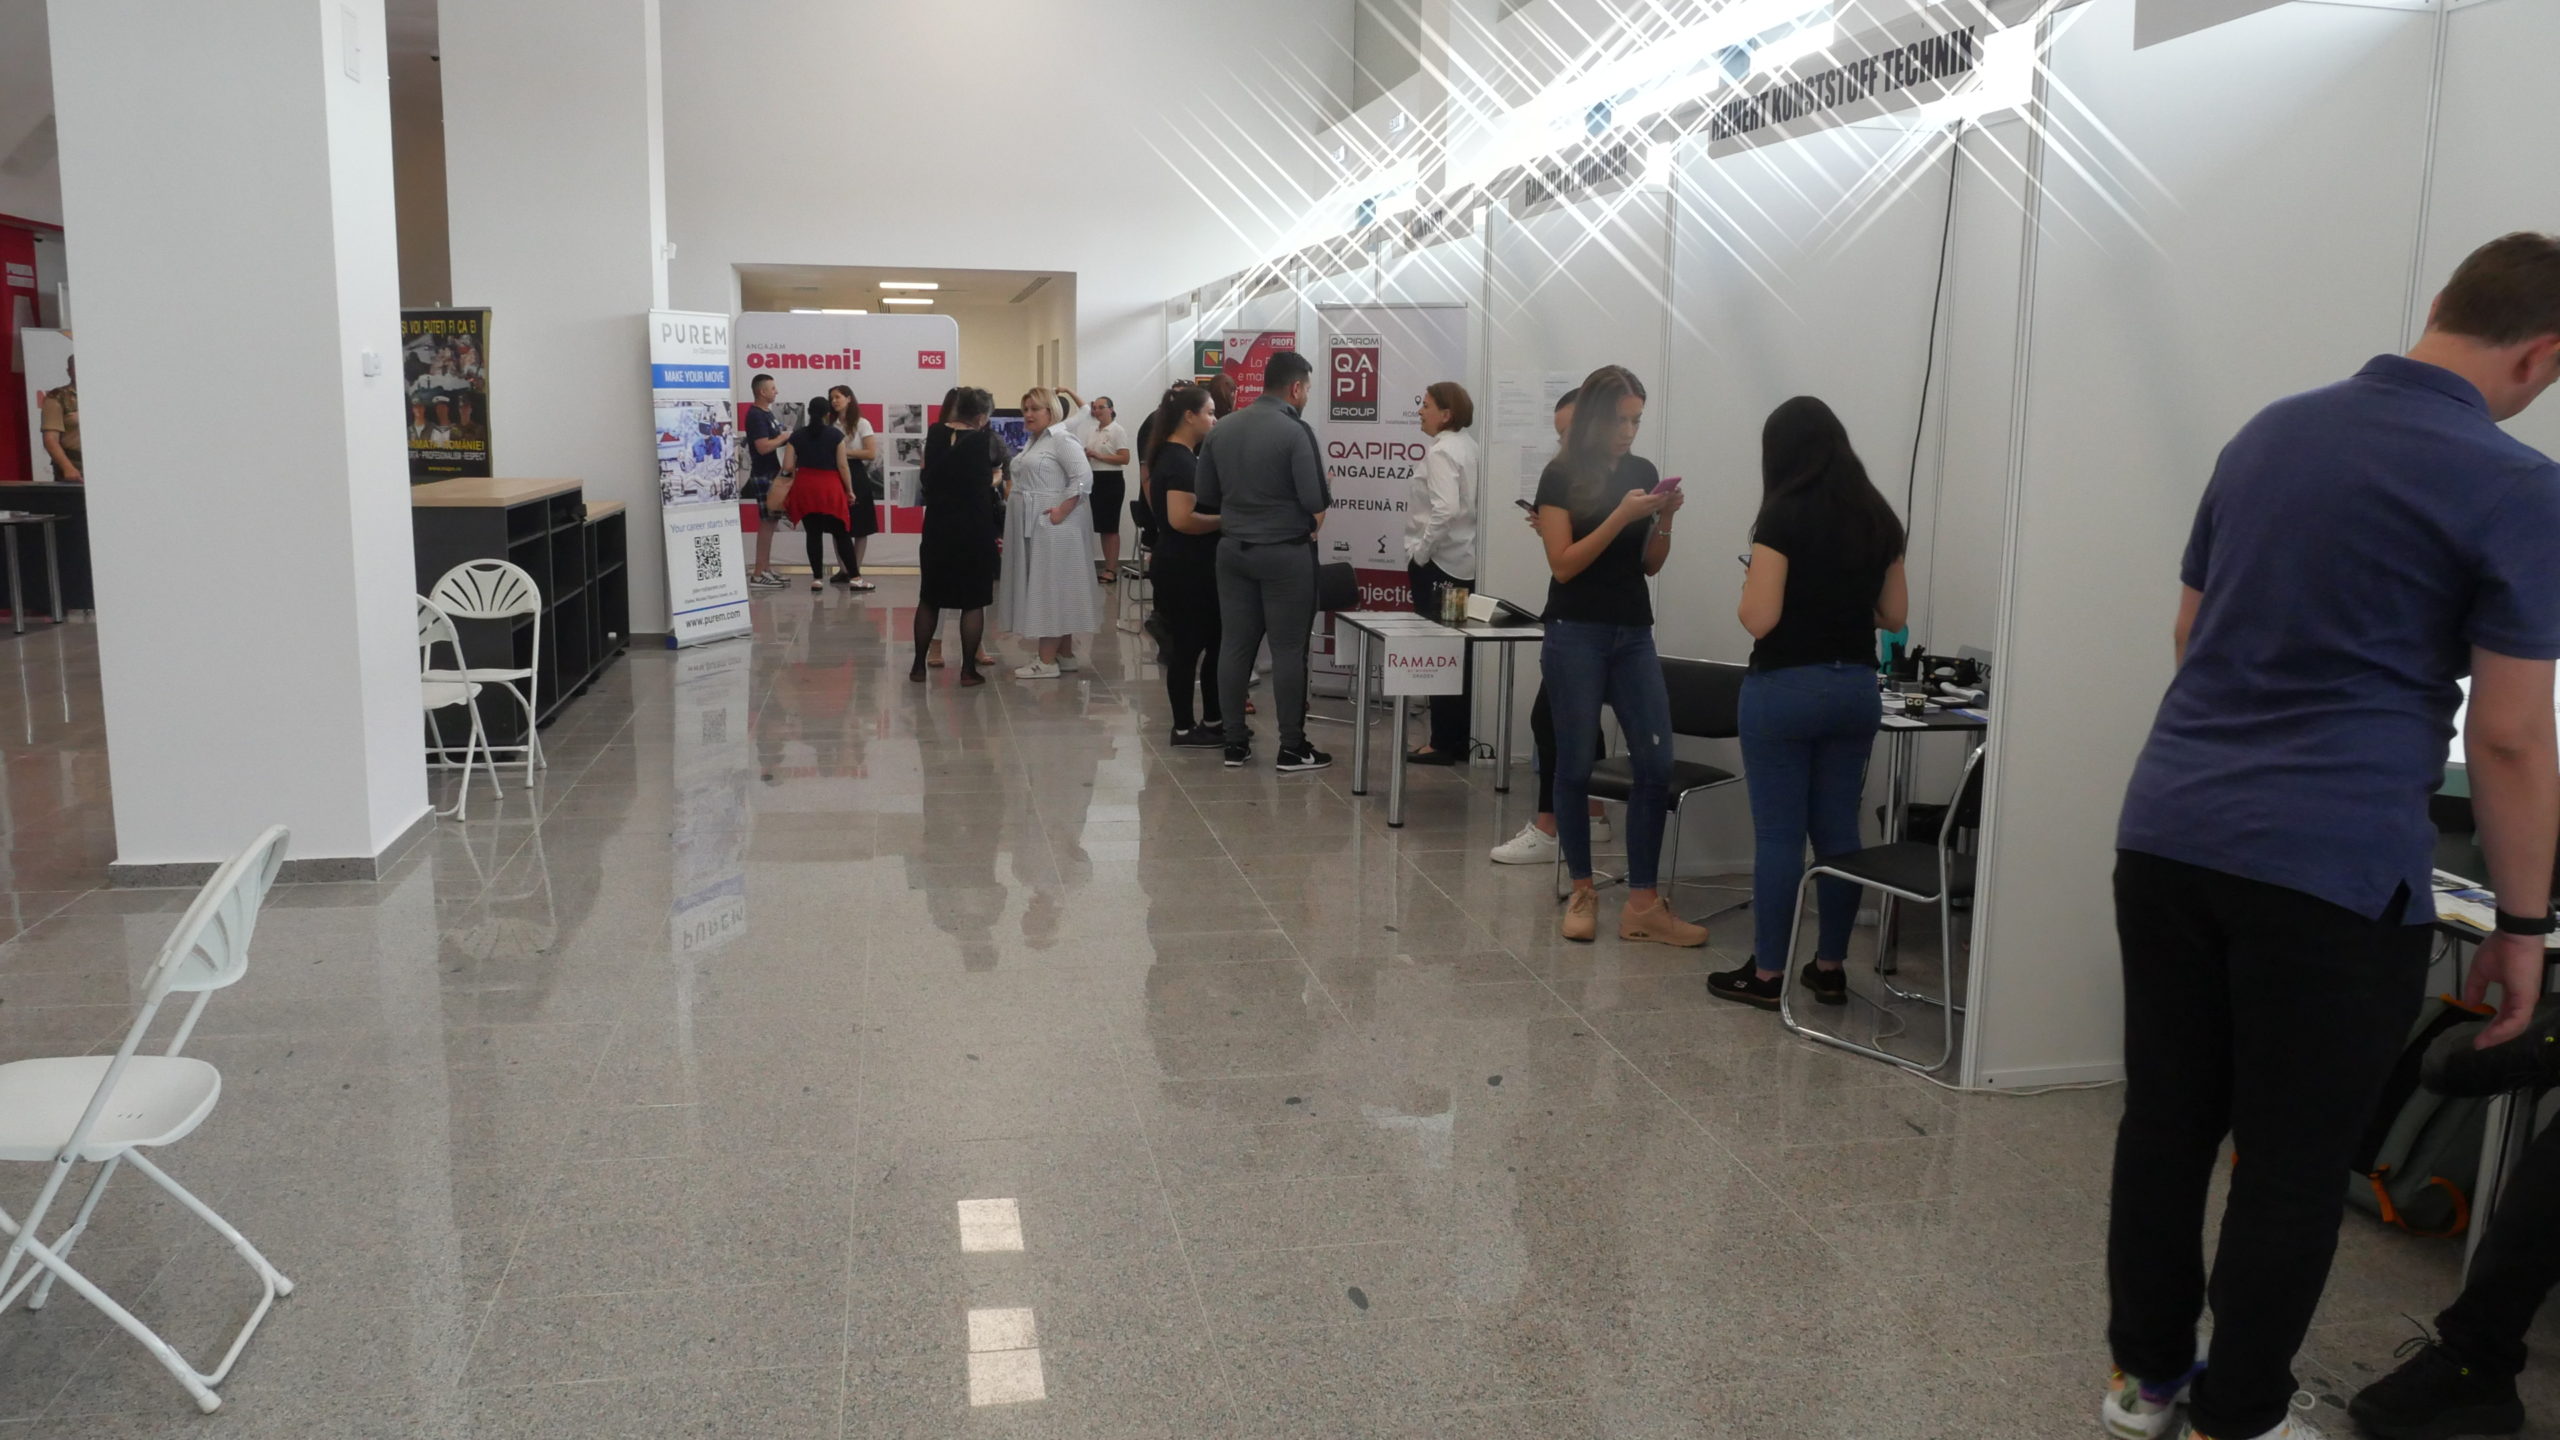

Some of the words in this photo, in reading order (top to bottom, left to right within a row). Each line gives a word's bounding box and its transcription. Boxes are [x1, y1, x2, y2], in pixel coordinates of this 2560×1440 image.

[1711, 91, 1769, 142] REINERT
[1770, 54, 1879, 125] KUNSTSTOFF
[1883, 25, 1976, 93] TECHNIK
[662, 322, 727, 345] PUREM
[1331, 337, 1379, 345] QAPIROM
[747, 348, 861, 370] oameni!
[921, 354, 942, 365] PGS
[664, 370, 684, 382] MAKE
[684, 370, 704, 382] YOUR
[704, 371, 725, 383] MOVE
[1332, 407, 1375, 417] GROUP
[1328, 441, 1426, 461] QAPIRO
[1330, 498, 1392, 512] MPREUNĂ
[1357, 583, 1414, 607] njecție
[1388, 653, 1457, 667] RAMADA
